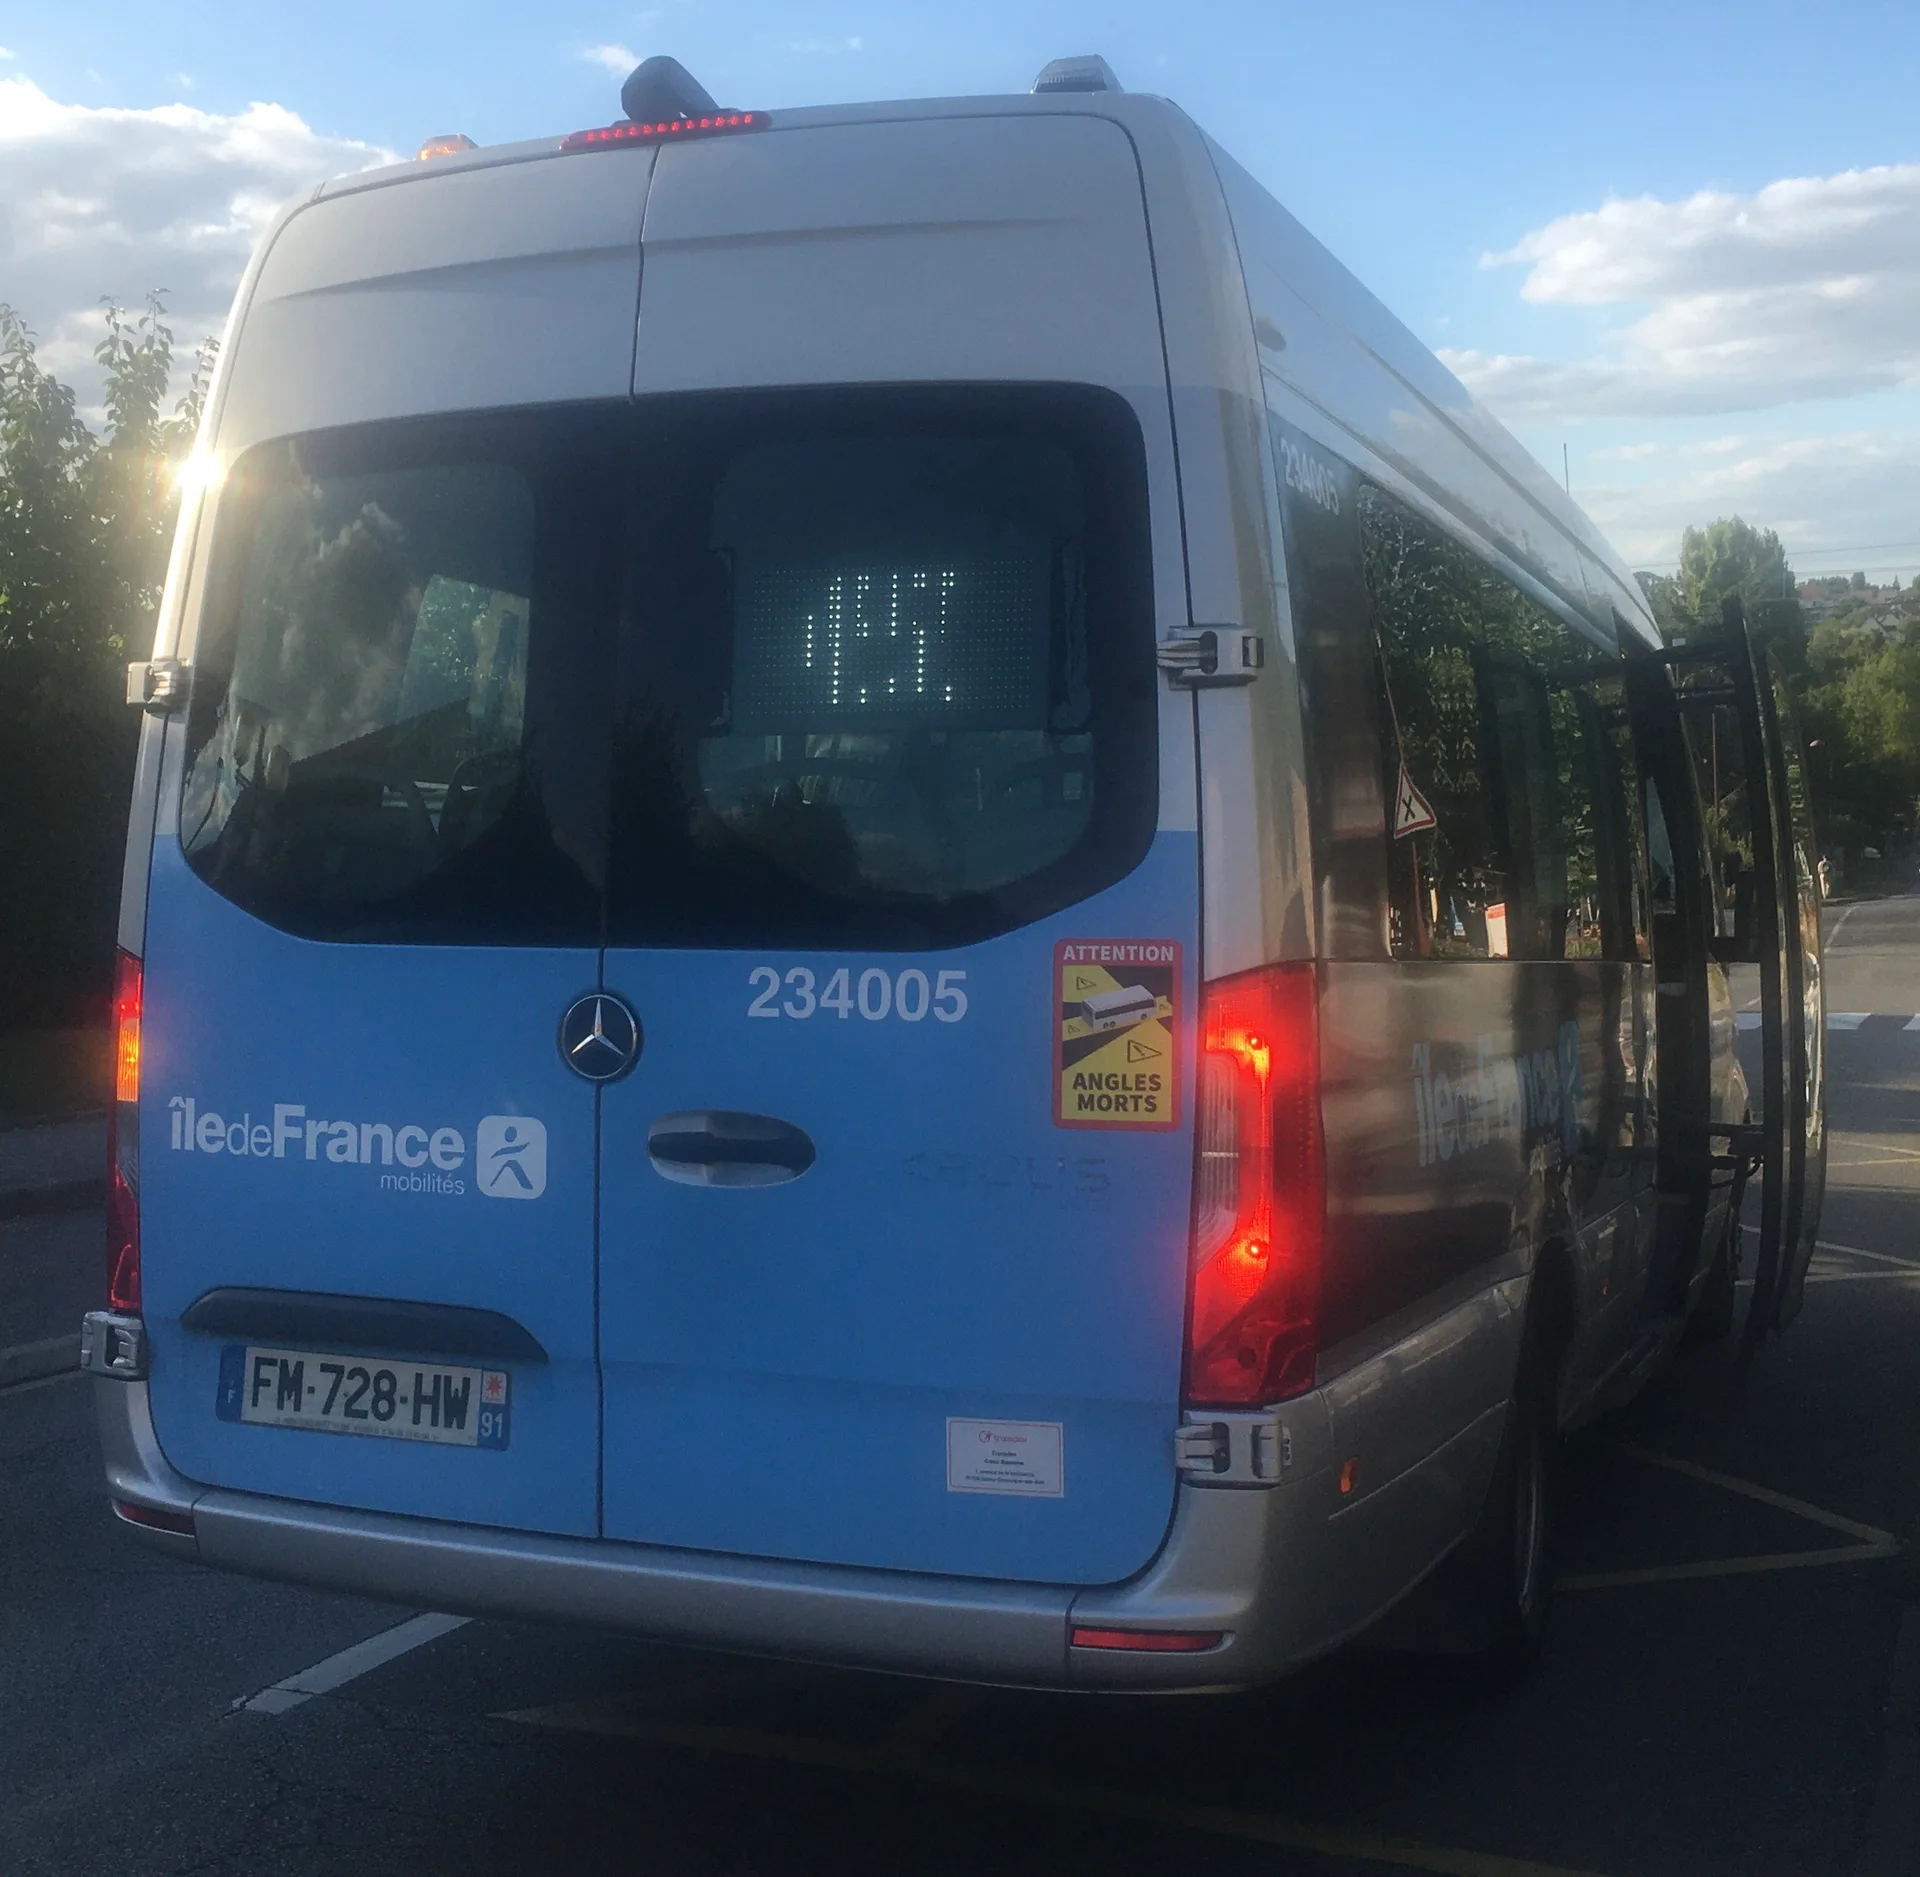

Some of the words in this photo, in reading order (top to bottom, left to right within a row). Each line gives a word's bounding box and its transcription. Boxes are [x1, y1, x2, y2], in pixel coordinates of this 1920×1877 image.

[1063, 945, 1174, 961] ATTENTION
[747, 966, 968, 1023] 234005
[1072, 1072, 1162, 1091] ANGLES
[1077, 1093, 1157, 1113] MORTS
[168, 1096, 465, 1170] îledeFrance
[380, 1172, 465, 1196] mobilités
[227, 1389, 235, 1404] F
[251, 1357, 471, 1430] FM-728-HW
[479, 1411, 503, 1438] 91
